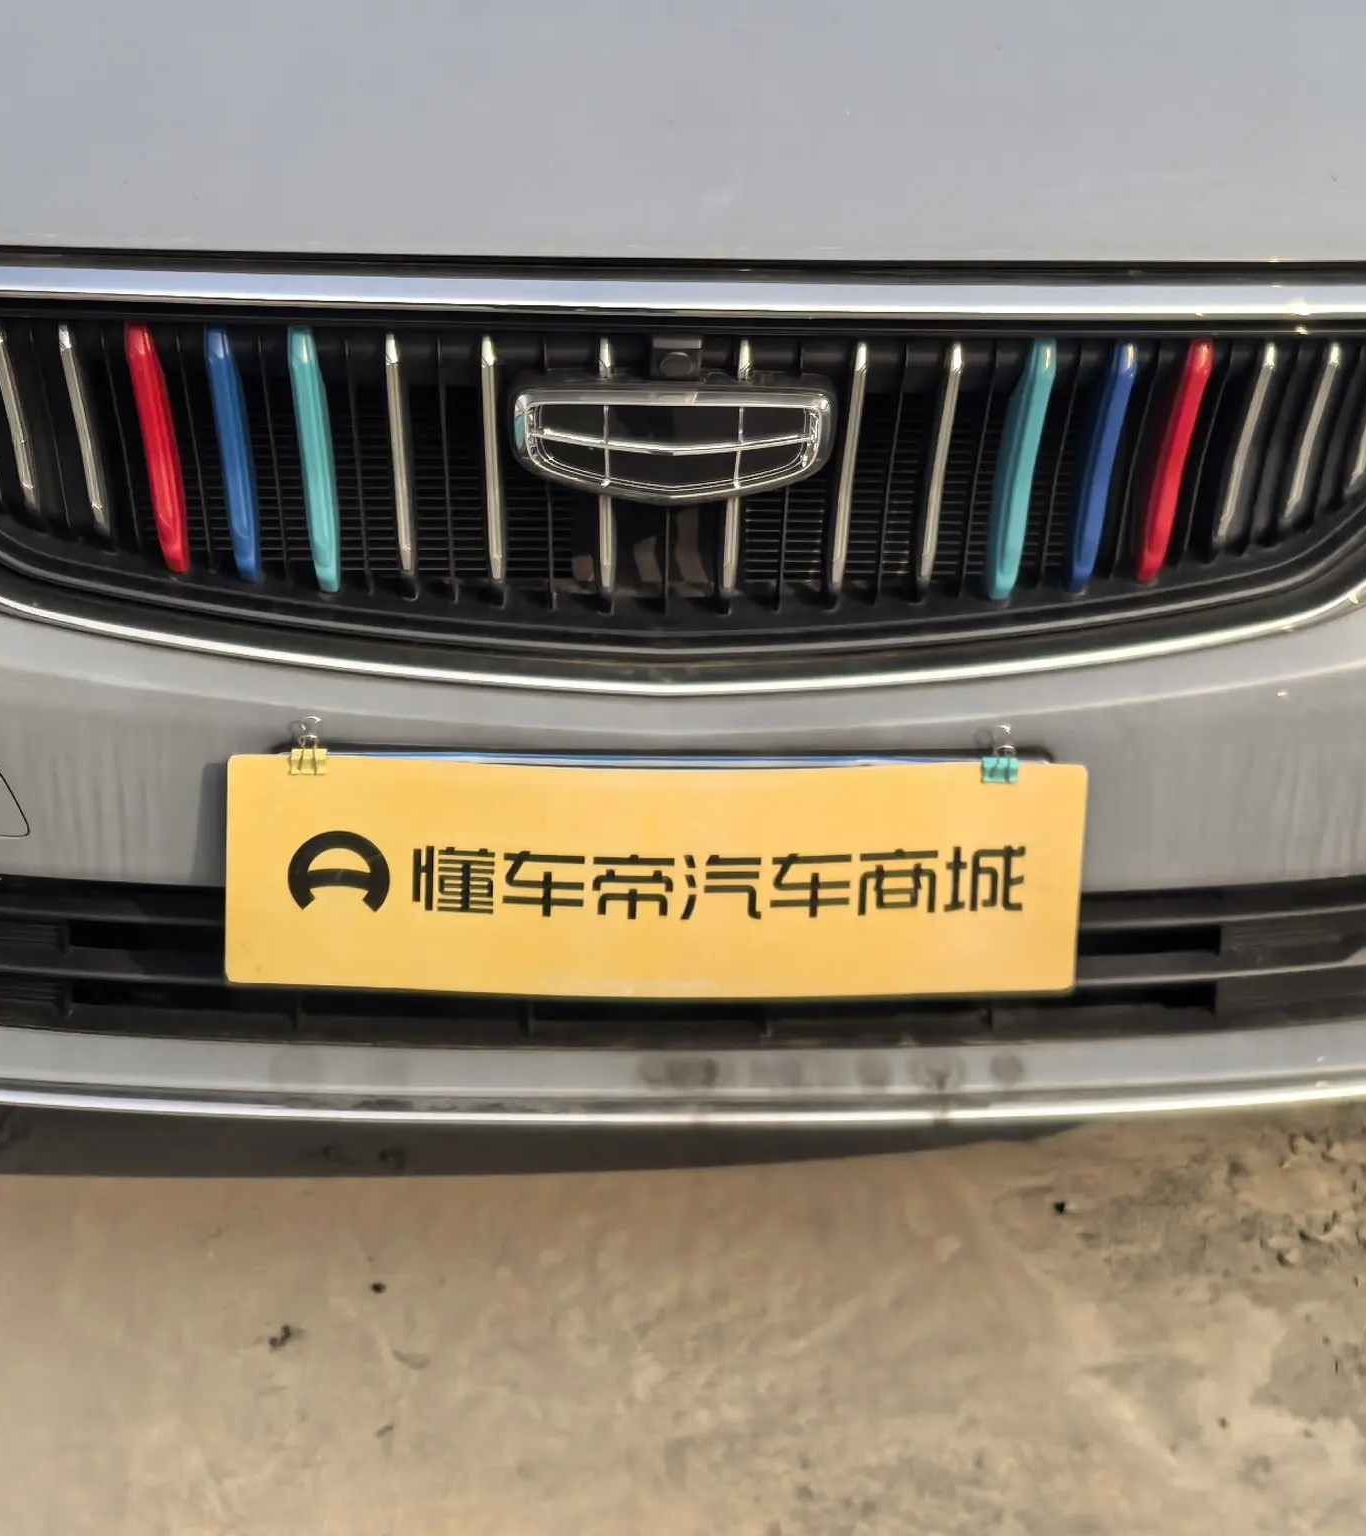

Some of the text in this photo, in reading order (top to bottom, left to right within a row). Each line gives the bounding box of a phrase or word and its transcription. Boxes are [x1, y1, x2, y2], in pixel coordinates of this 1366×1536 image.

[412, 845, 1026, 920] 懂车帝汽车商城
